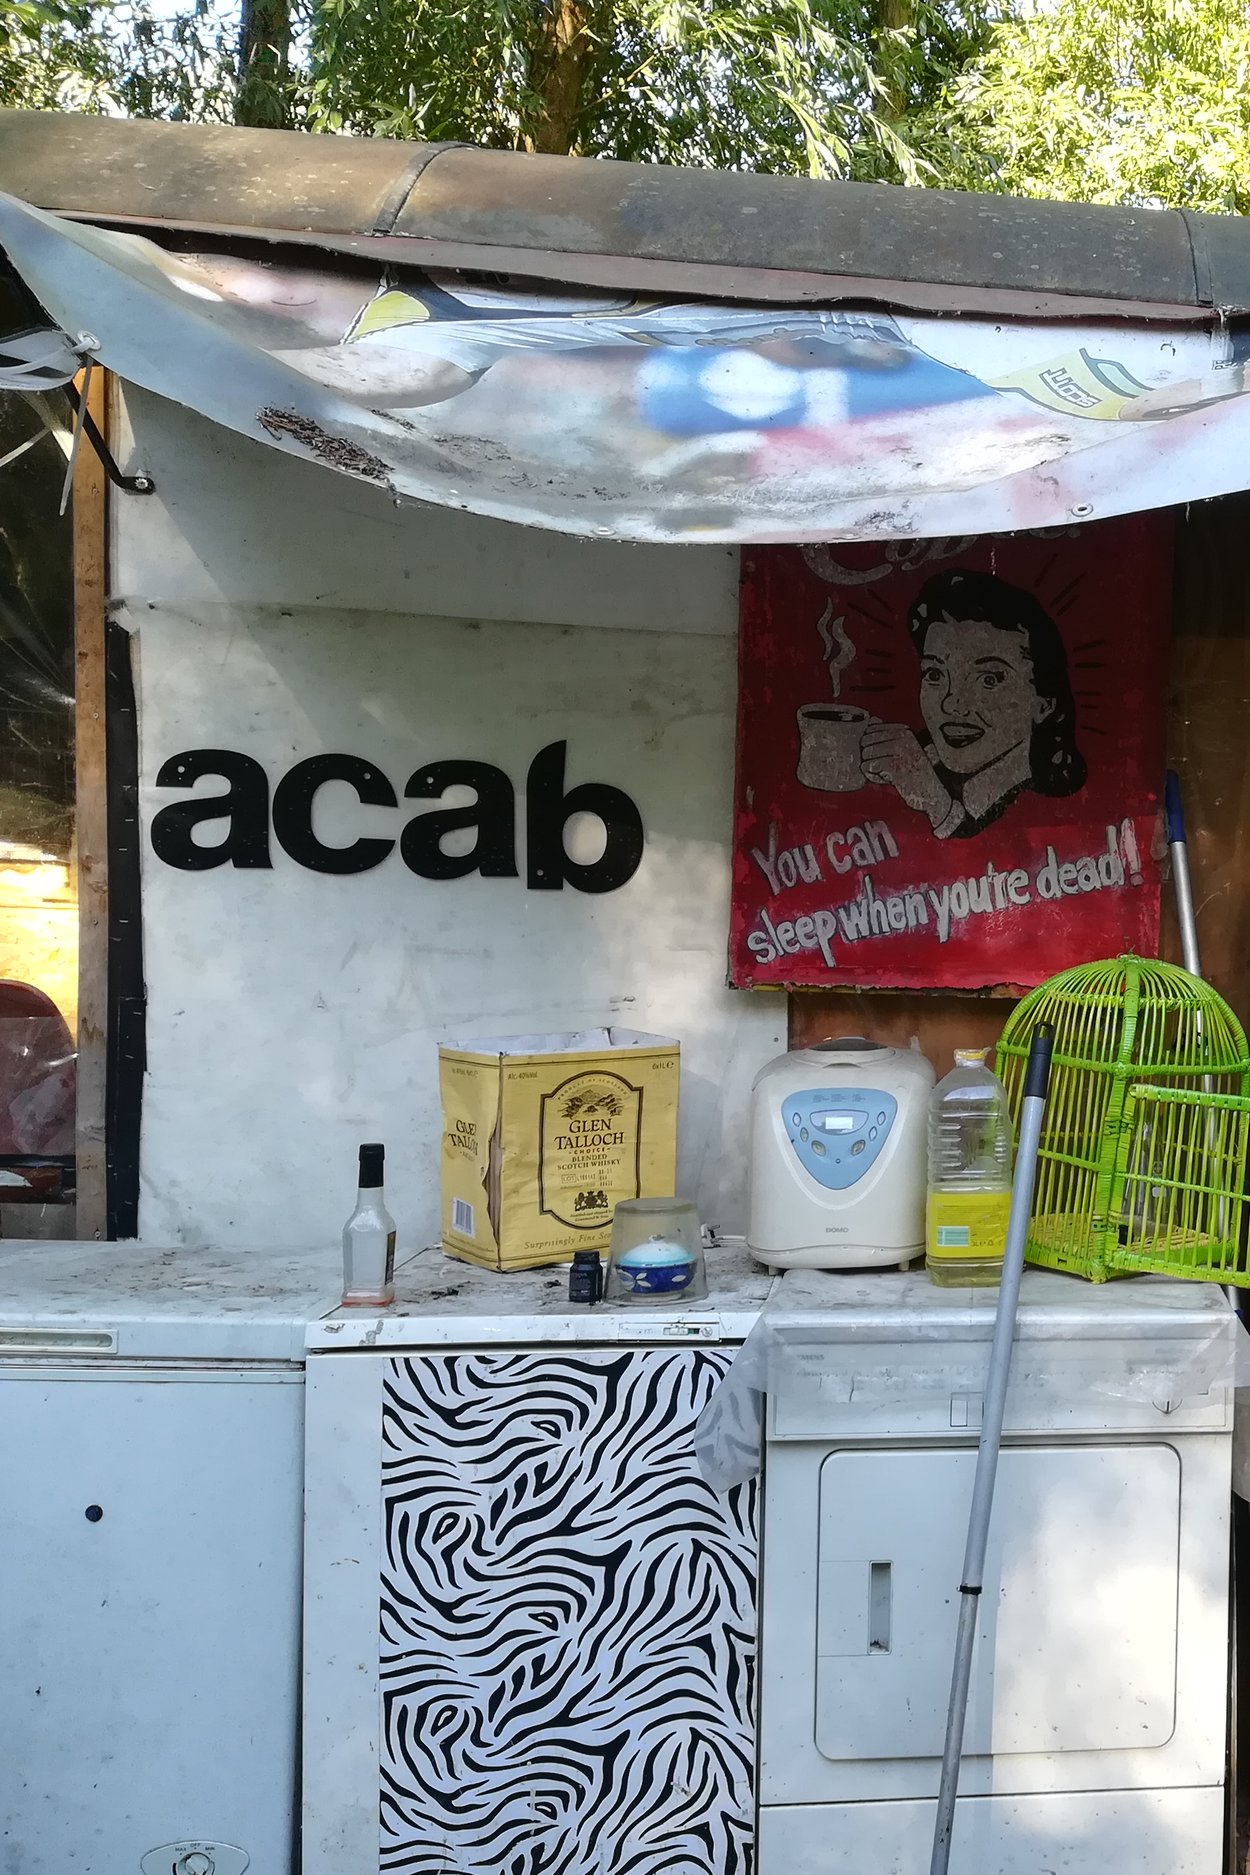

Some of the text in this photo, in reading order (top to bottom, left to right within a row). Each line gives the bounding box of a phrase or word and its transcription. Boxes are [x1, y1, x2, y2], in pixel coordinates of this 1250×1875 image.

[150, 739, 645, 894] acab
[751, 819, 900, 896] You can
[747, 908, 837, 968] sleep
[837, 874, 930, 943] when
[1035, 816, 1143, 900] dead!
[569, 1118, 612, 1134] GLEN
[554, 1132, 624, 1151] TALLOCH
[557, 1158, 622, 1171] SCOTCH WHISKY
[572, 1154, 608, 1163] BLENDED
[524, 1236, 576, 1250] Surprisingly
[579, 1234, 596, 1243] Fine
